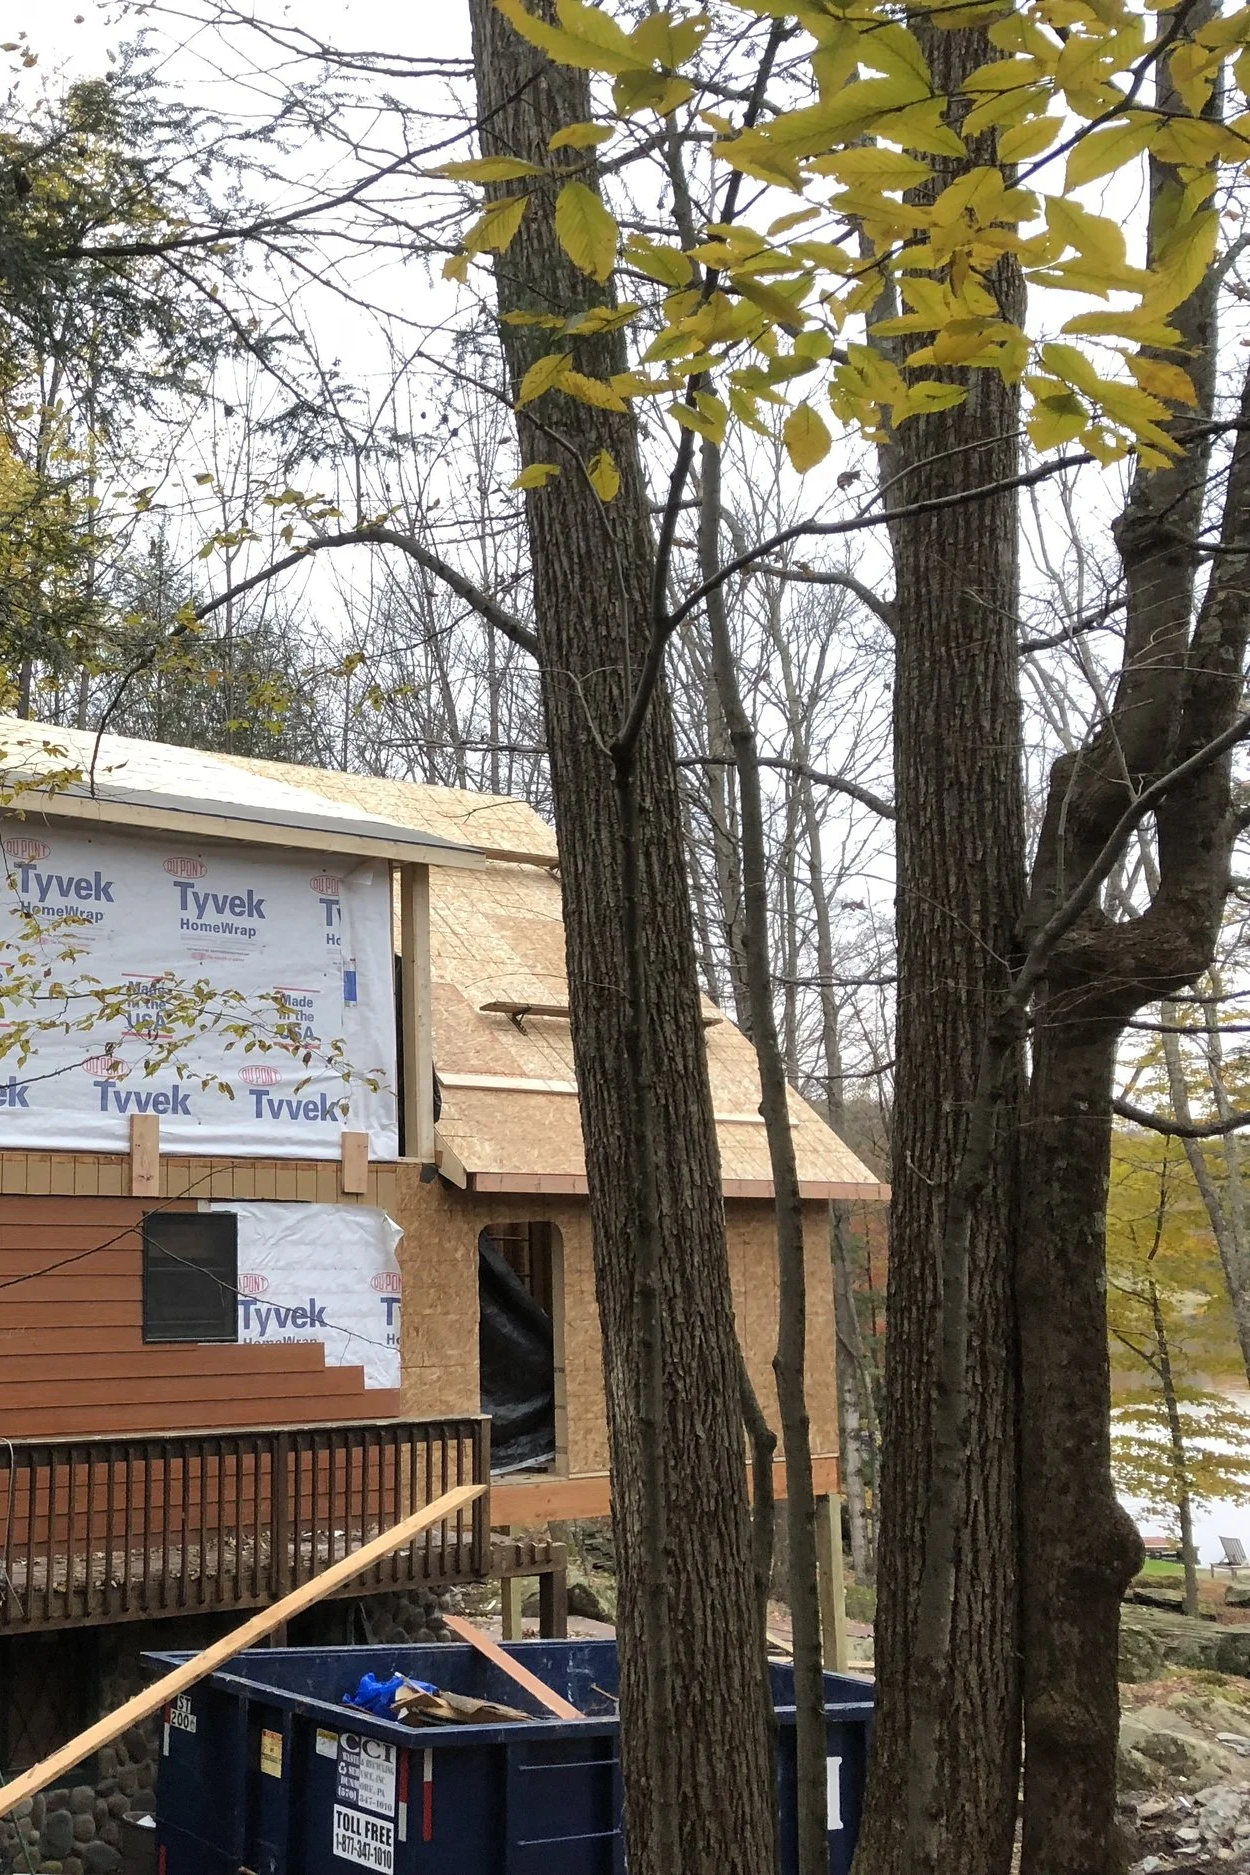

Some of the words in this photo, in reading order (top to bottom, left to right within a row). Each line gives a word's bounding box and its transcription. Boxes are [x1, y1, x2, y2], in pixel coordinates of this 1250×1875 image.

[13, 861, 115, 903] Tyvek
[20, 900, 104, 923] HomeWrap
[173, 881, 266, 920] Tyvek
[180, 917, 257, 939] HomeWrap
[281, 993, 314, 1008] Made
[295, 1009, 315, 1022] the
[93, 1080, 192, 1116] Tyvek
[249, 1089, 339, 1122] Tyvek
[238, 1297, 328, 1338] Tyvek
[340, 1732, 394, 1764] CCI
[338, 1785, 357, 1801] (570)
[359, 1794, 393, 1813] 347-1010
[336, 1810, 362, 1837] TOLL
[365, 1820, 392, 1848] FREE
[335, 1832, 392, 1870] 1-877-347-1010
